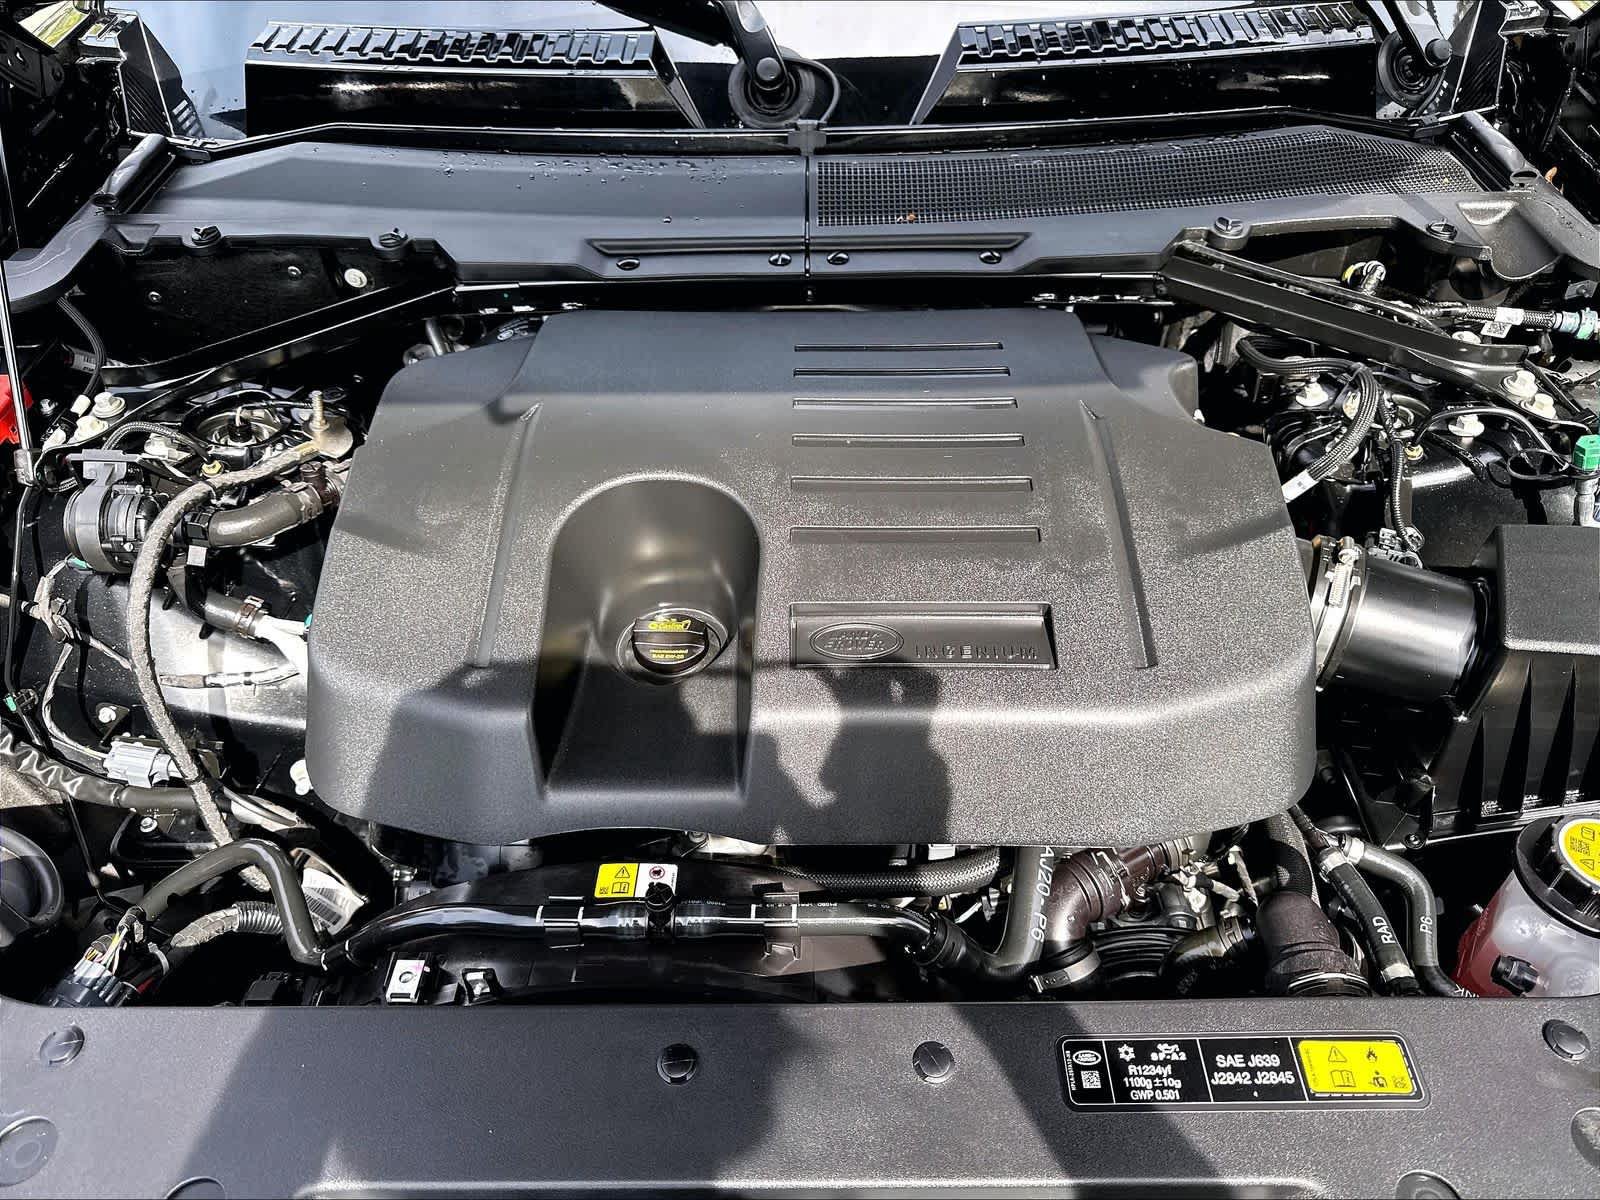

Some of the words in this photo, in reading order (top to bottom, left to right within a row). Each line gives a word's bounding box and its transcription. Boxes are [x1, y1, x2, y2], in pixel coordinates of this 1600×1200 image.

[1372, 916, 1396, 944] RAD
[1420, 915, 1433, 934] P6
[1215, 1054, 1246, 1067] SAE
[1247, 1053, 1280, 1067] J639
[1127, 1064, 1172, 1077] R1234yf
[1211, 1071, 1252, 1085] J2842
[1254, 1070, 1295, 1084] J2845
[1123, 1076, 1153, 1089] 1100g
[1153, 1077, 1182, 1089] ±10g
[1130, 1089, 1154, 1100] GWP
[1155, 1089, 1180, 1100] 0.501
